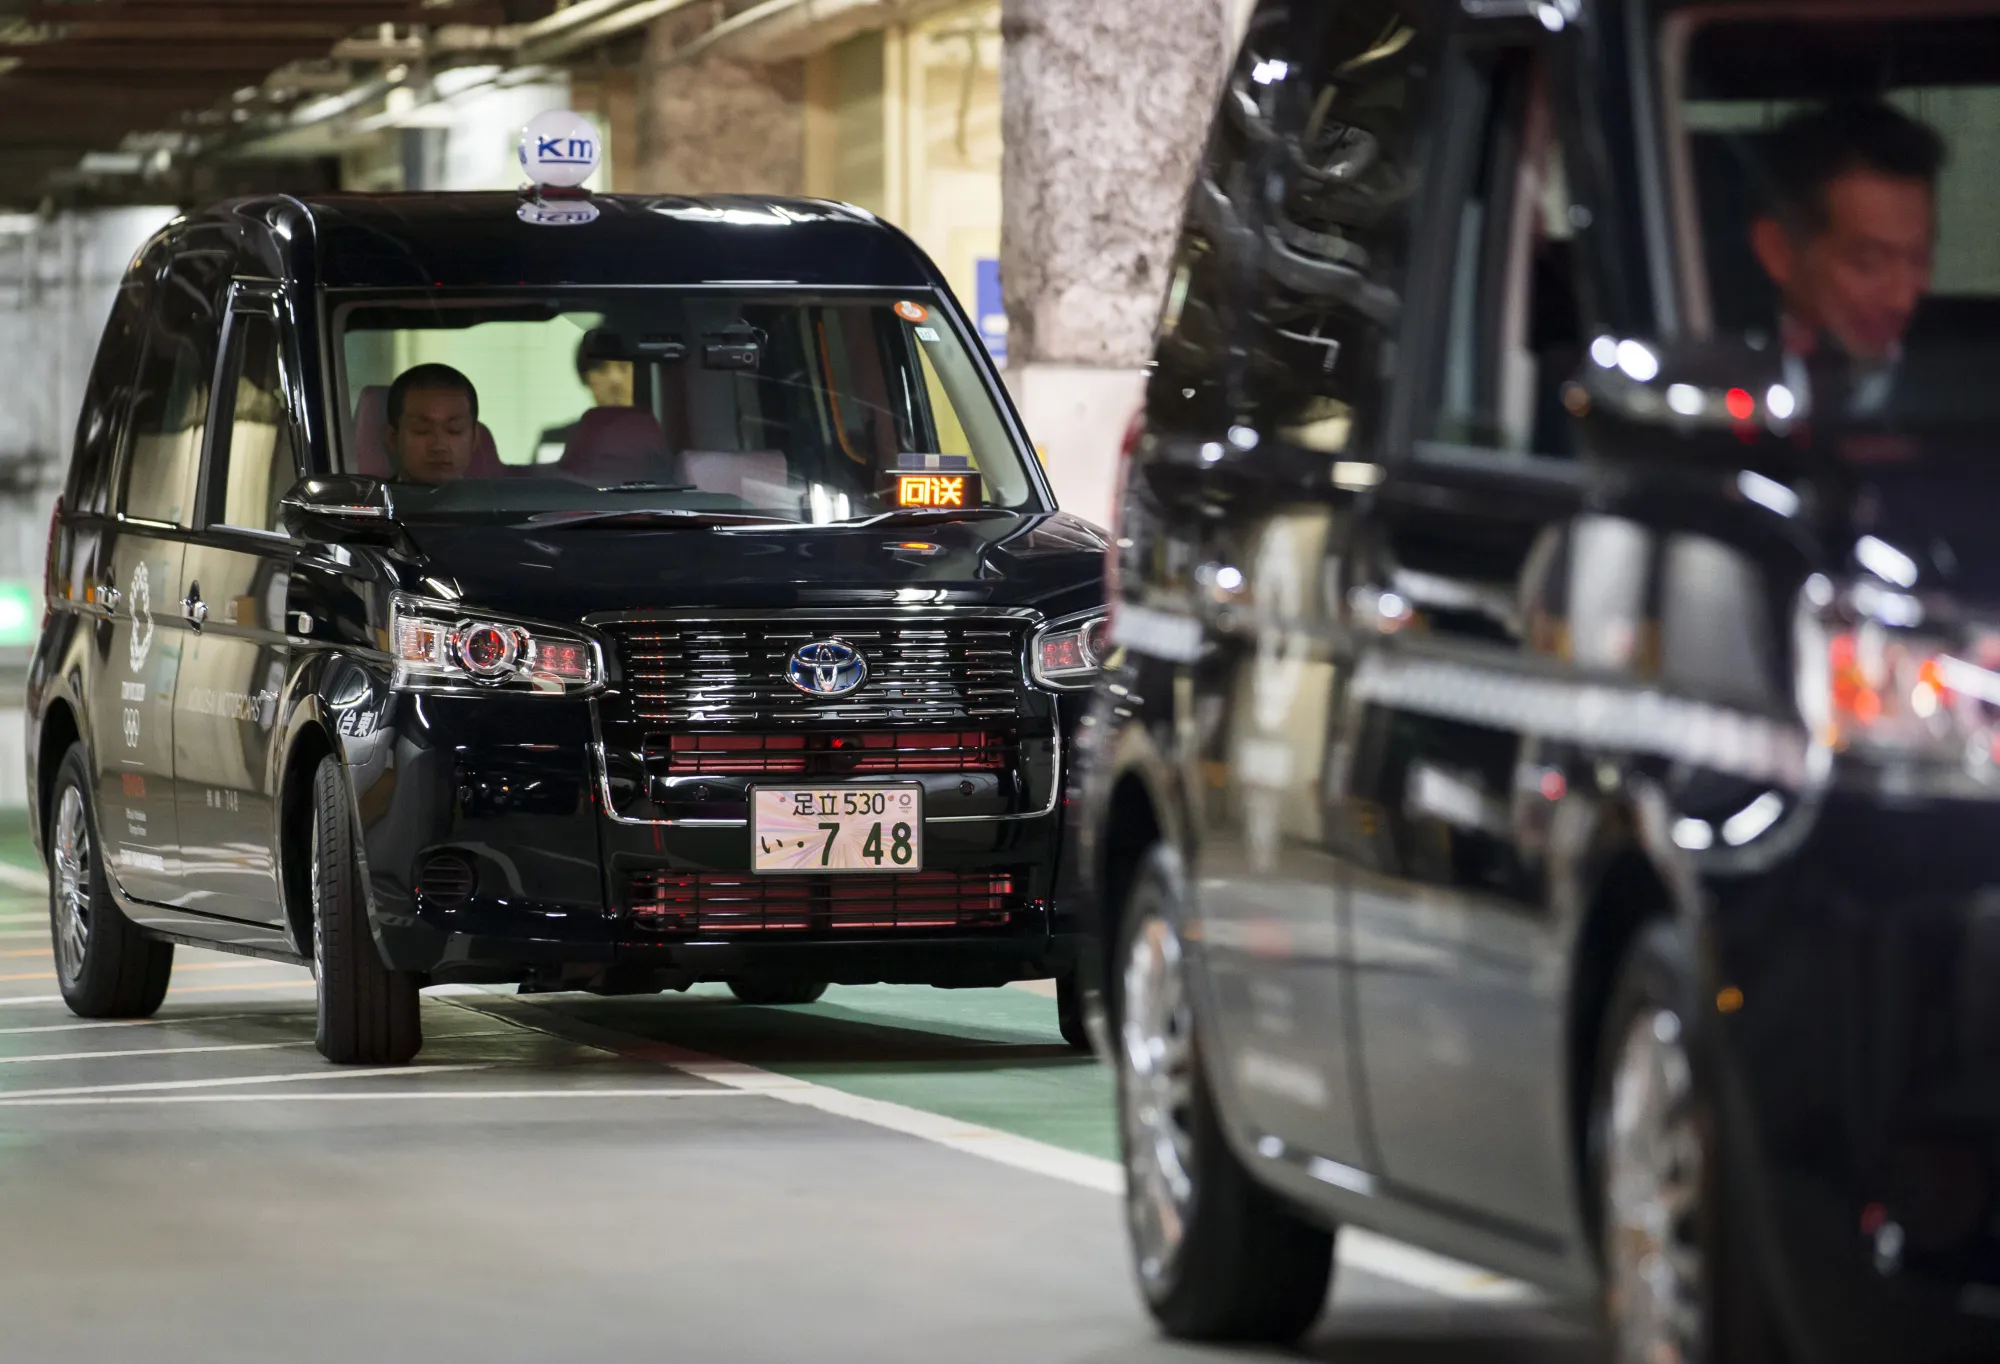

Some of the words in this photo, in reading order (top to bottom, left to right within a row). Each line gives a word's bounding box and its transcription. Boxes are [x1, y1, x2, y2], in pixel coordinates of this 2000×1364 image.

[900, 477, 963, 505] 回送
[792, 793, 840, 816] 足立
[844, 793, 886, 815] 530
